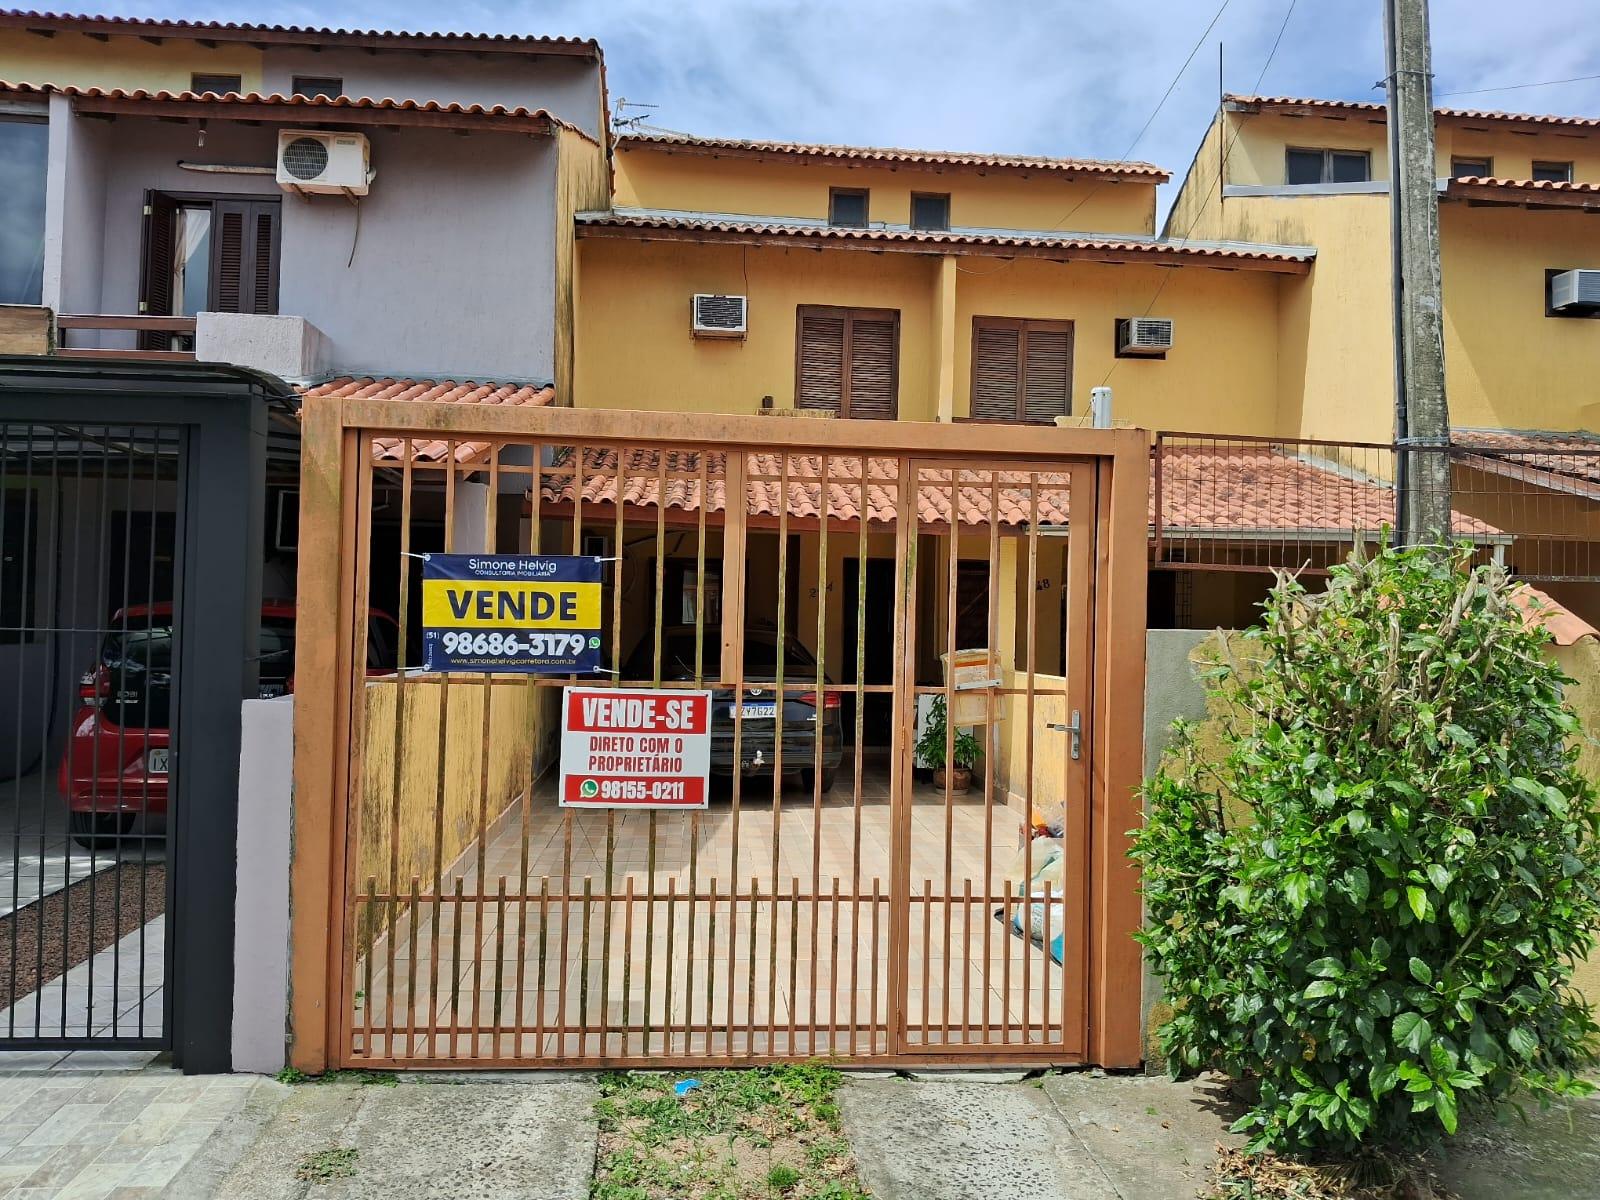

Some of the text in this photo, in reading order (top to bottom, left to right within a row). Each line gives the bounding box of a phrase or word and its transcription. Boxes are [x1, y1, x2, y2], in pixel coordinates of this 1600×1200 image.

[468, 559, 557, 573] Simone Helvig
[447, 590, 577, 621] VENDE
[426, 632, 440, 640] (51)
[442, 632, 585, 656] 98686-3179
[582, 698, 694, 730] VENDE-SE
[589, 736, 683, 754] DIRETO COM O
[588, 754, 683, 773] PROPRIETÁRIO
[601, 781, 685, 800] 98155-0211
